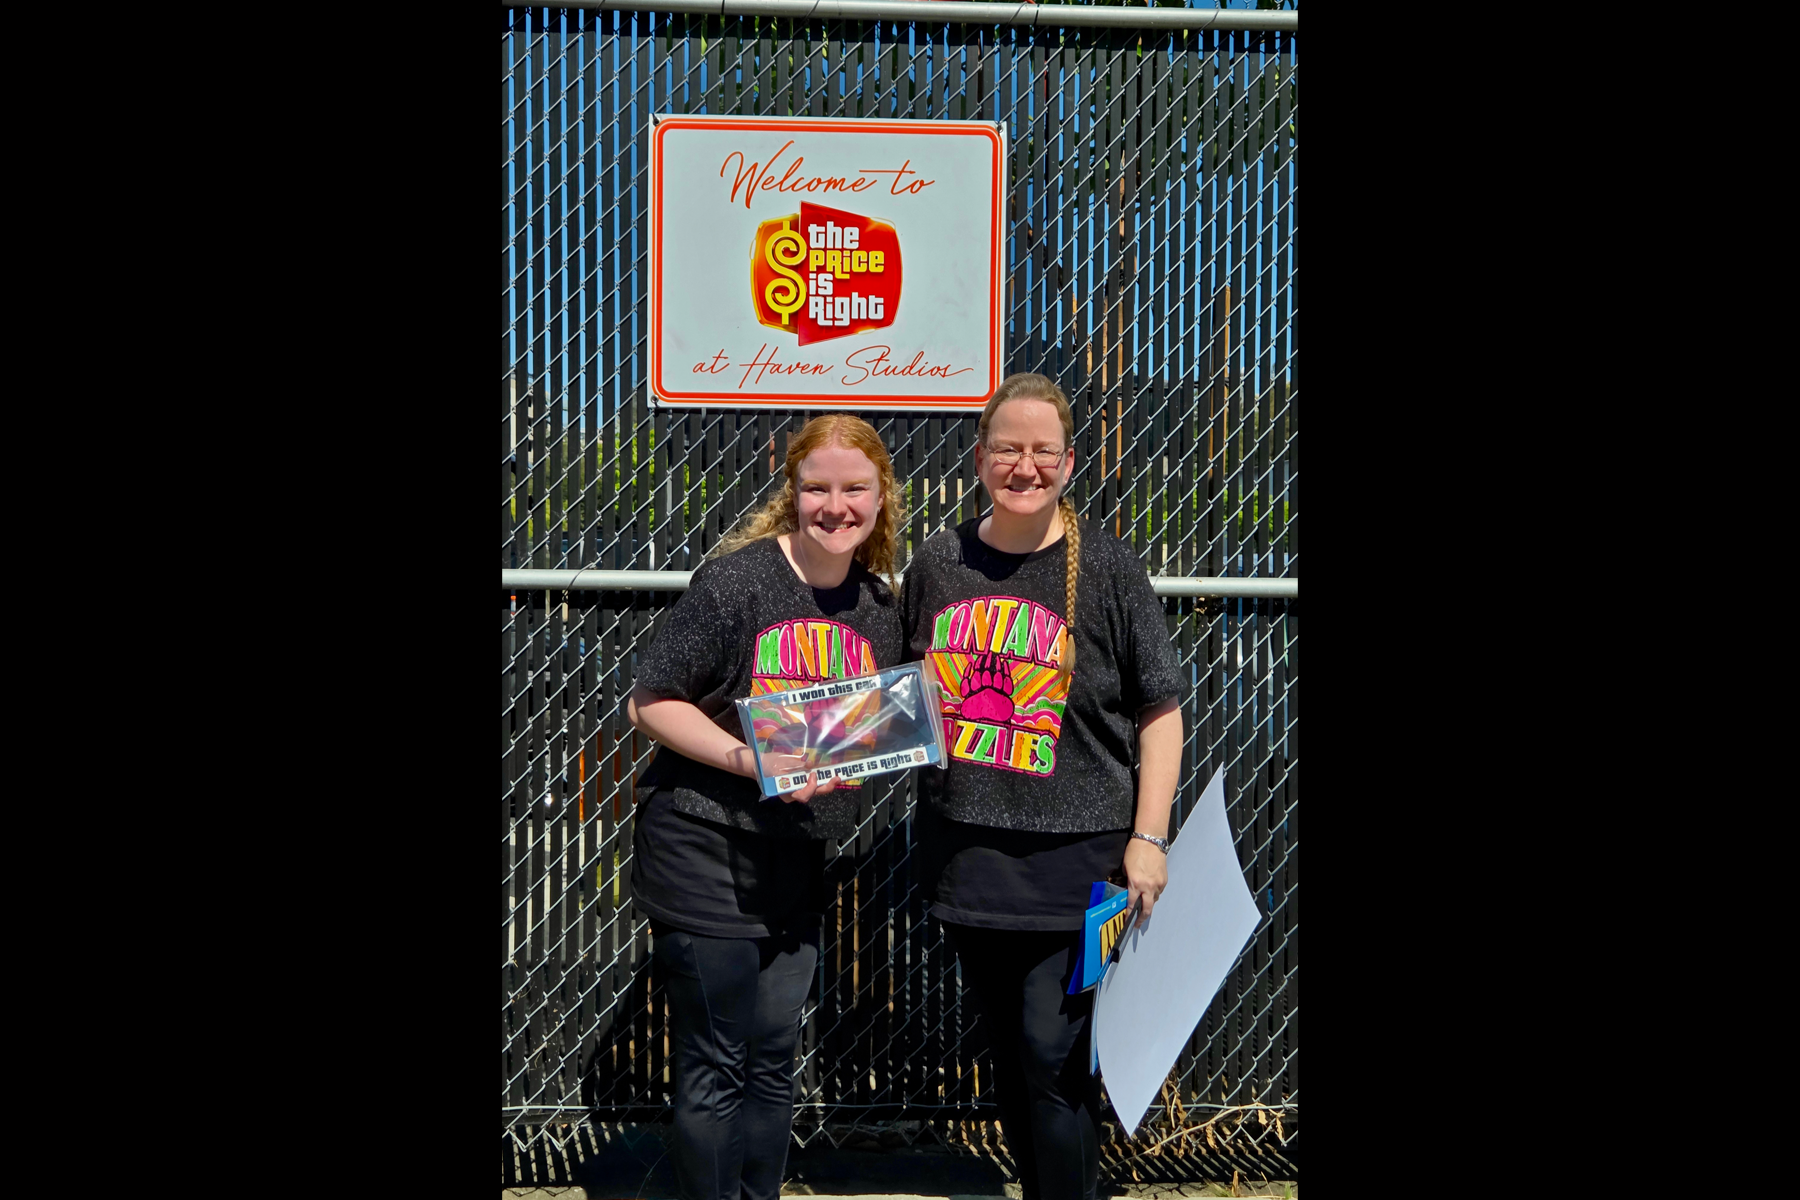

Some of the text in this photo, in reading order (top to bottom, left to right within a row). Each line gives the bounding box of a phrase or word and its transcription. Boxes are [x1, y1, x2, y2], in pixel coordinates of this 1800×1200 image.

[720, 140, 936, 209] Welcome to
[808, 221, 860, 250] the
[809, 273, 834, 295] is
[808, 292, 885, 326] Right
[692, 343, 975, 389] at Haven Studios
[931, 599, 1068, 666] MONTANA
[755, 621, 876, 679] MONTANA
[792, 693, 797, 702] I
[799, 688, 826, 701] won
[827, 684, 853, 697] this
[792, 774, 808, 786] on
[813, 769, 832, 781] he
[867, 760, 878, 771] is
[880, 753, 912, 769] Right
